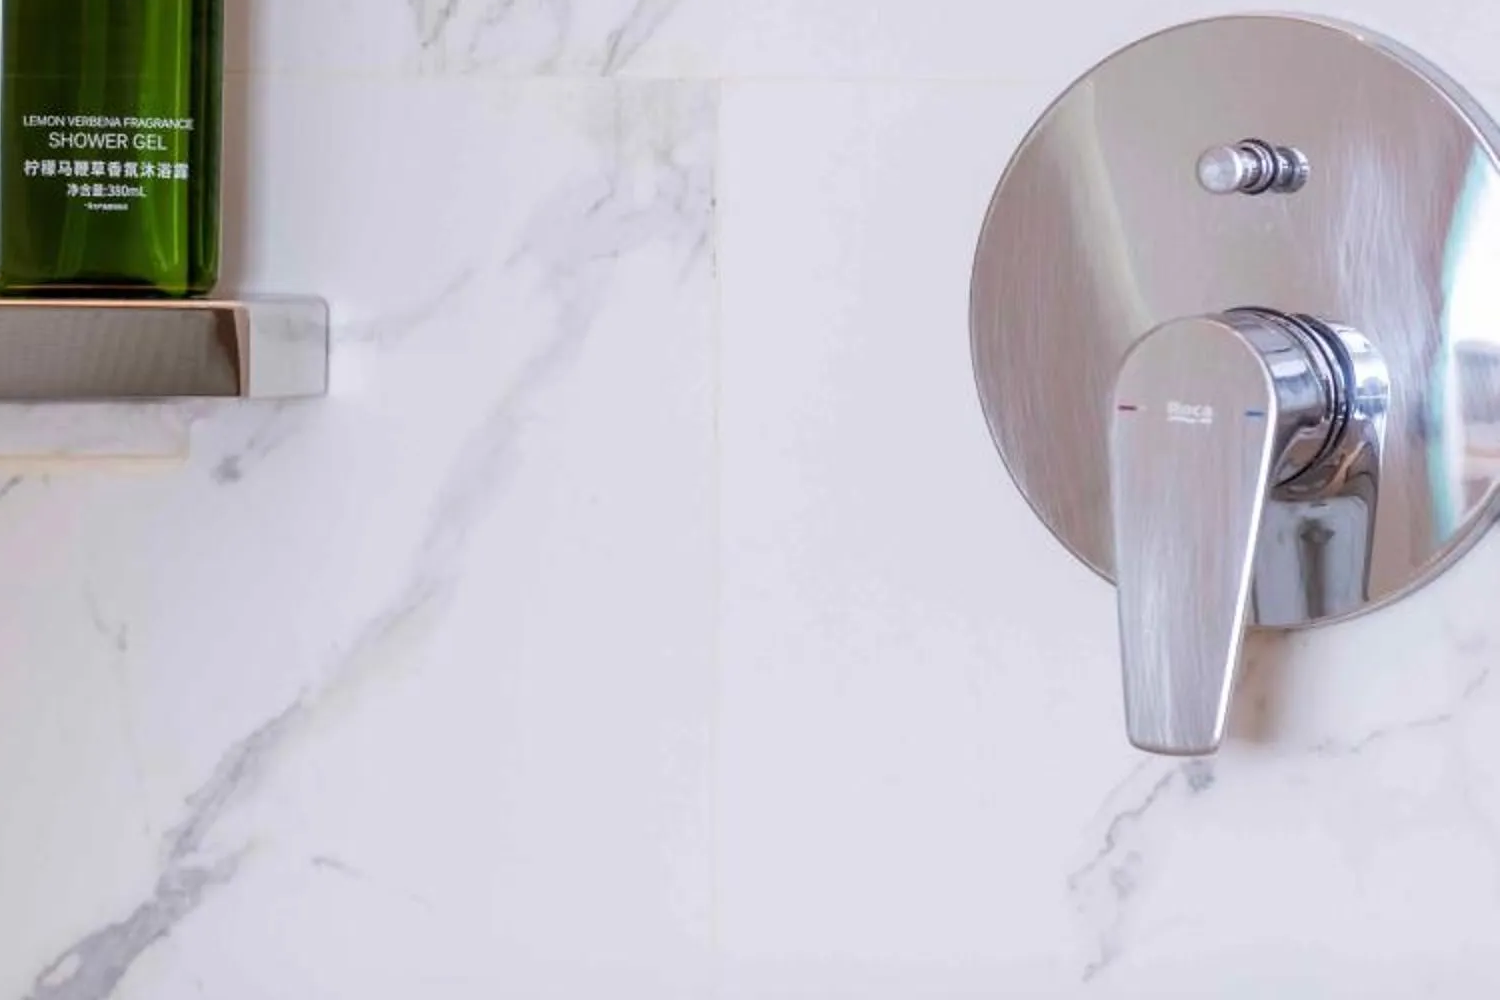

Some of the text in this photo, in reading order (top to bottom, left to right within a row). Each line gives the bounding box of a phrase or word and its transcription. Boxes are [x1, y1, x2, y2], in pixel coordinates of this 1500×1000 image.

[23, 115, 195, 130] LEMON VERBENA FRAGRANCE
[49, 131, 168, 150] SHOWER GEL
